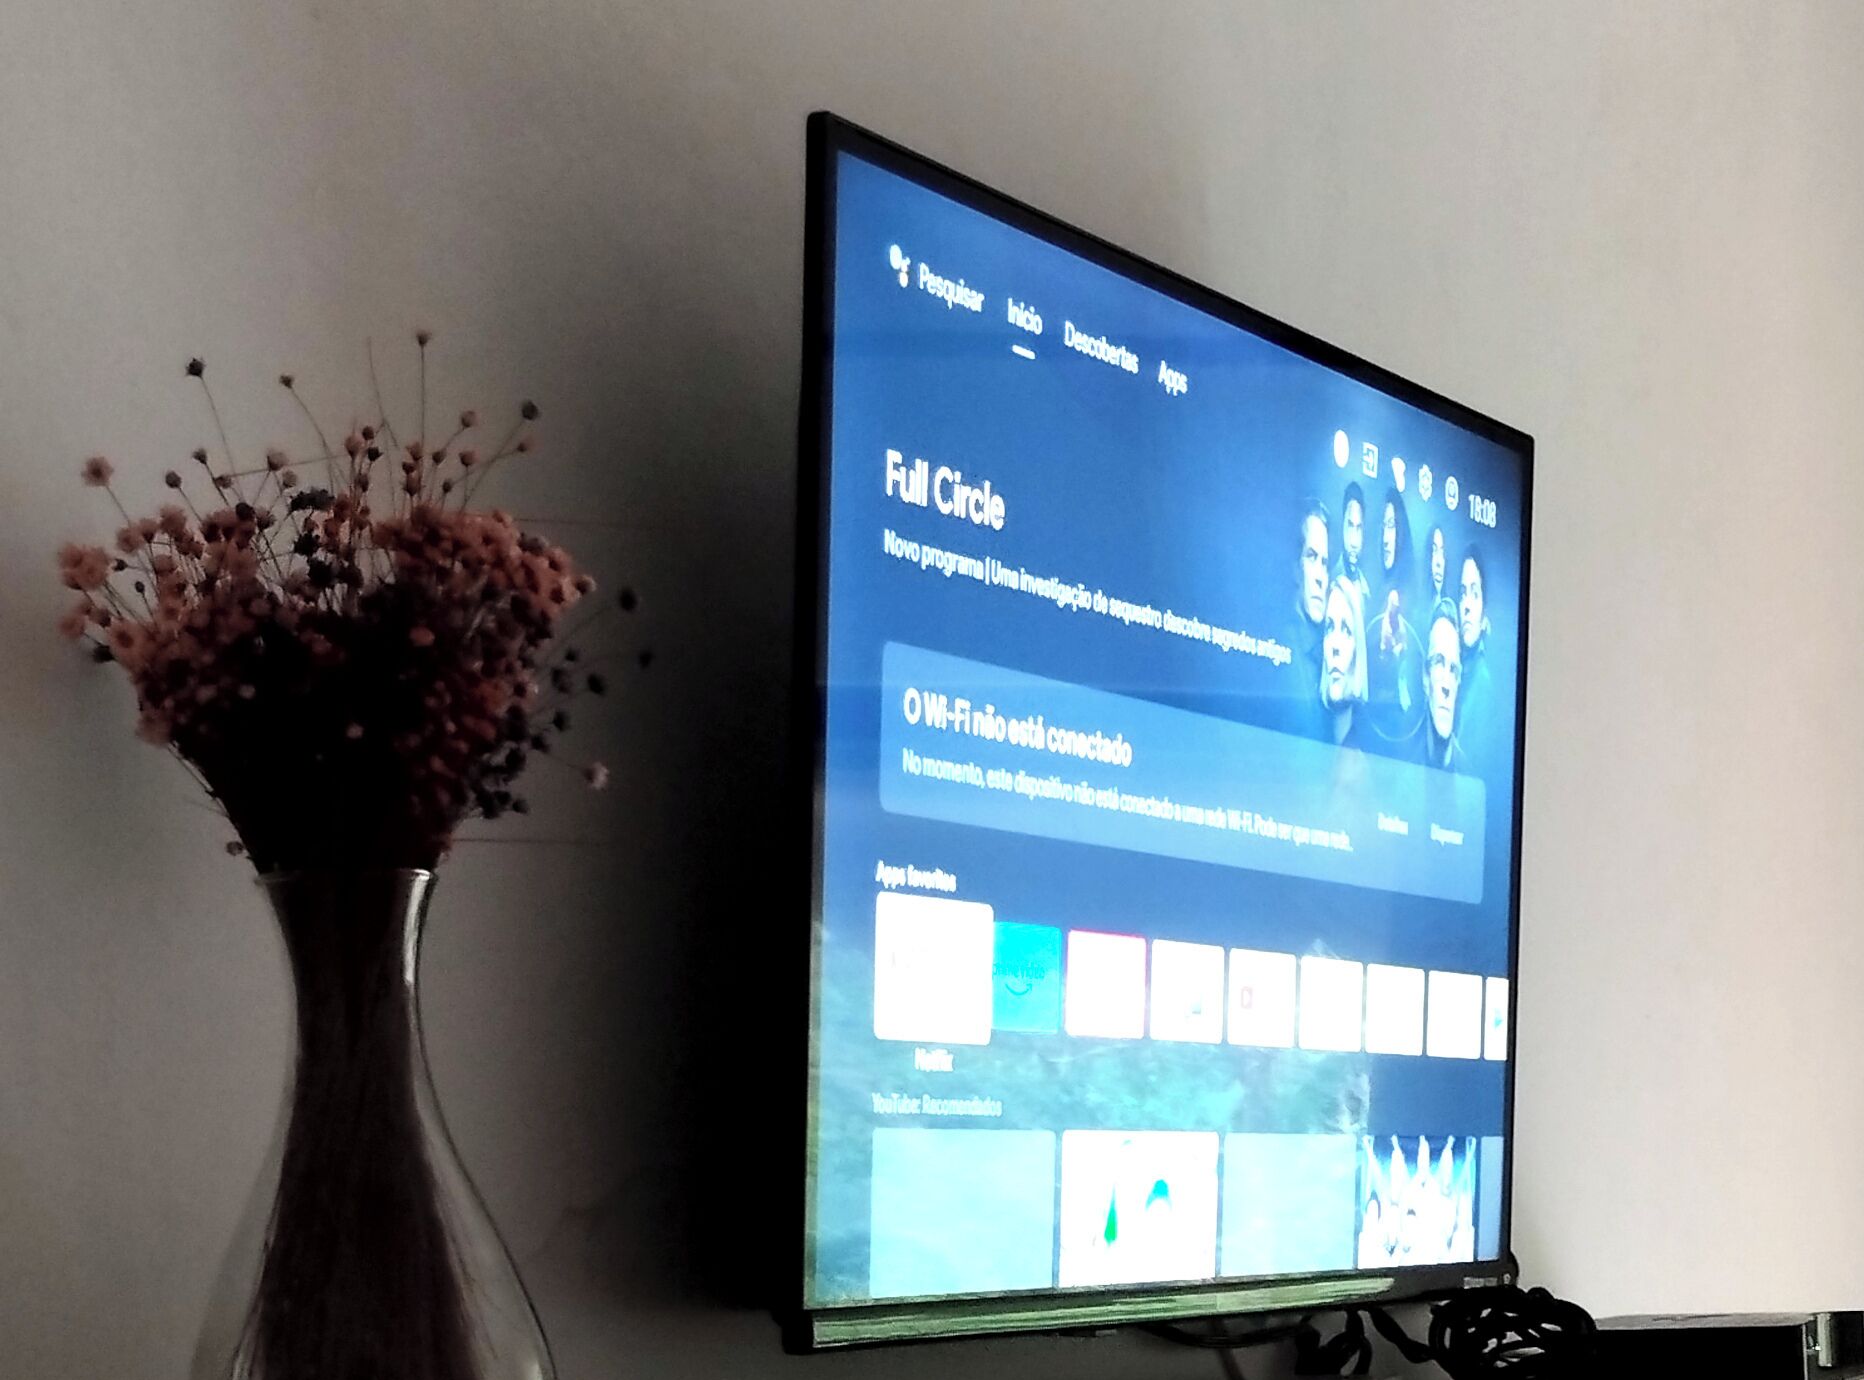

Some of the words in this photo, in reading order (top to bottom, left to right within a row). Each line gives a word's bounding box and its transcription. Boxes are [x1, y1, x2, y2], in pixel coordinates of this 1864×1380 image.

[919, 262, 984, 313] Pesquisar
[1064, 320, 1139, 374] Descobertas
[1158, 360, 1188, 396] Apps
[886, 448, 929, 507] Full
[934, 466, 1005, 531] Circle
[884, 528, 921, 562] Novo
[921, 545, 984, 577] programa
[991, 559, 1019, 590] Uma
[1020, 567, 1092, 613] investigação
[1093, 589, 1108, 615] de
[903, 687, 922, 725] O
[924, 690, 971, 734] Wi-Fi
[973, 704, 1006, 743] não
[1007, 715, 1045, 751] está
[1046, 730, 1133, 768] conectado
[902, 747, 922, 776] No
[922, 757, 985, 789] momento,
[986, 768, 1013, 793] este
[1014, 770, 1073, 801] dispositivo
[1073, 781, 1095, 807] não
[1096, 785, 1120, 811] está
[1120, 793, 1174, 820] conectado
[875, 860, 906, 889] Apps
